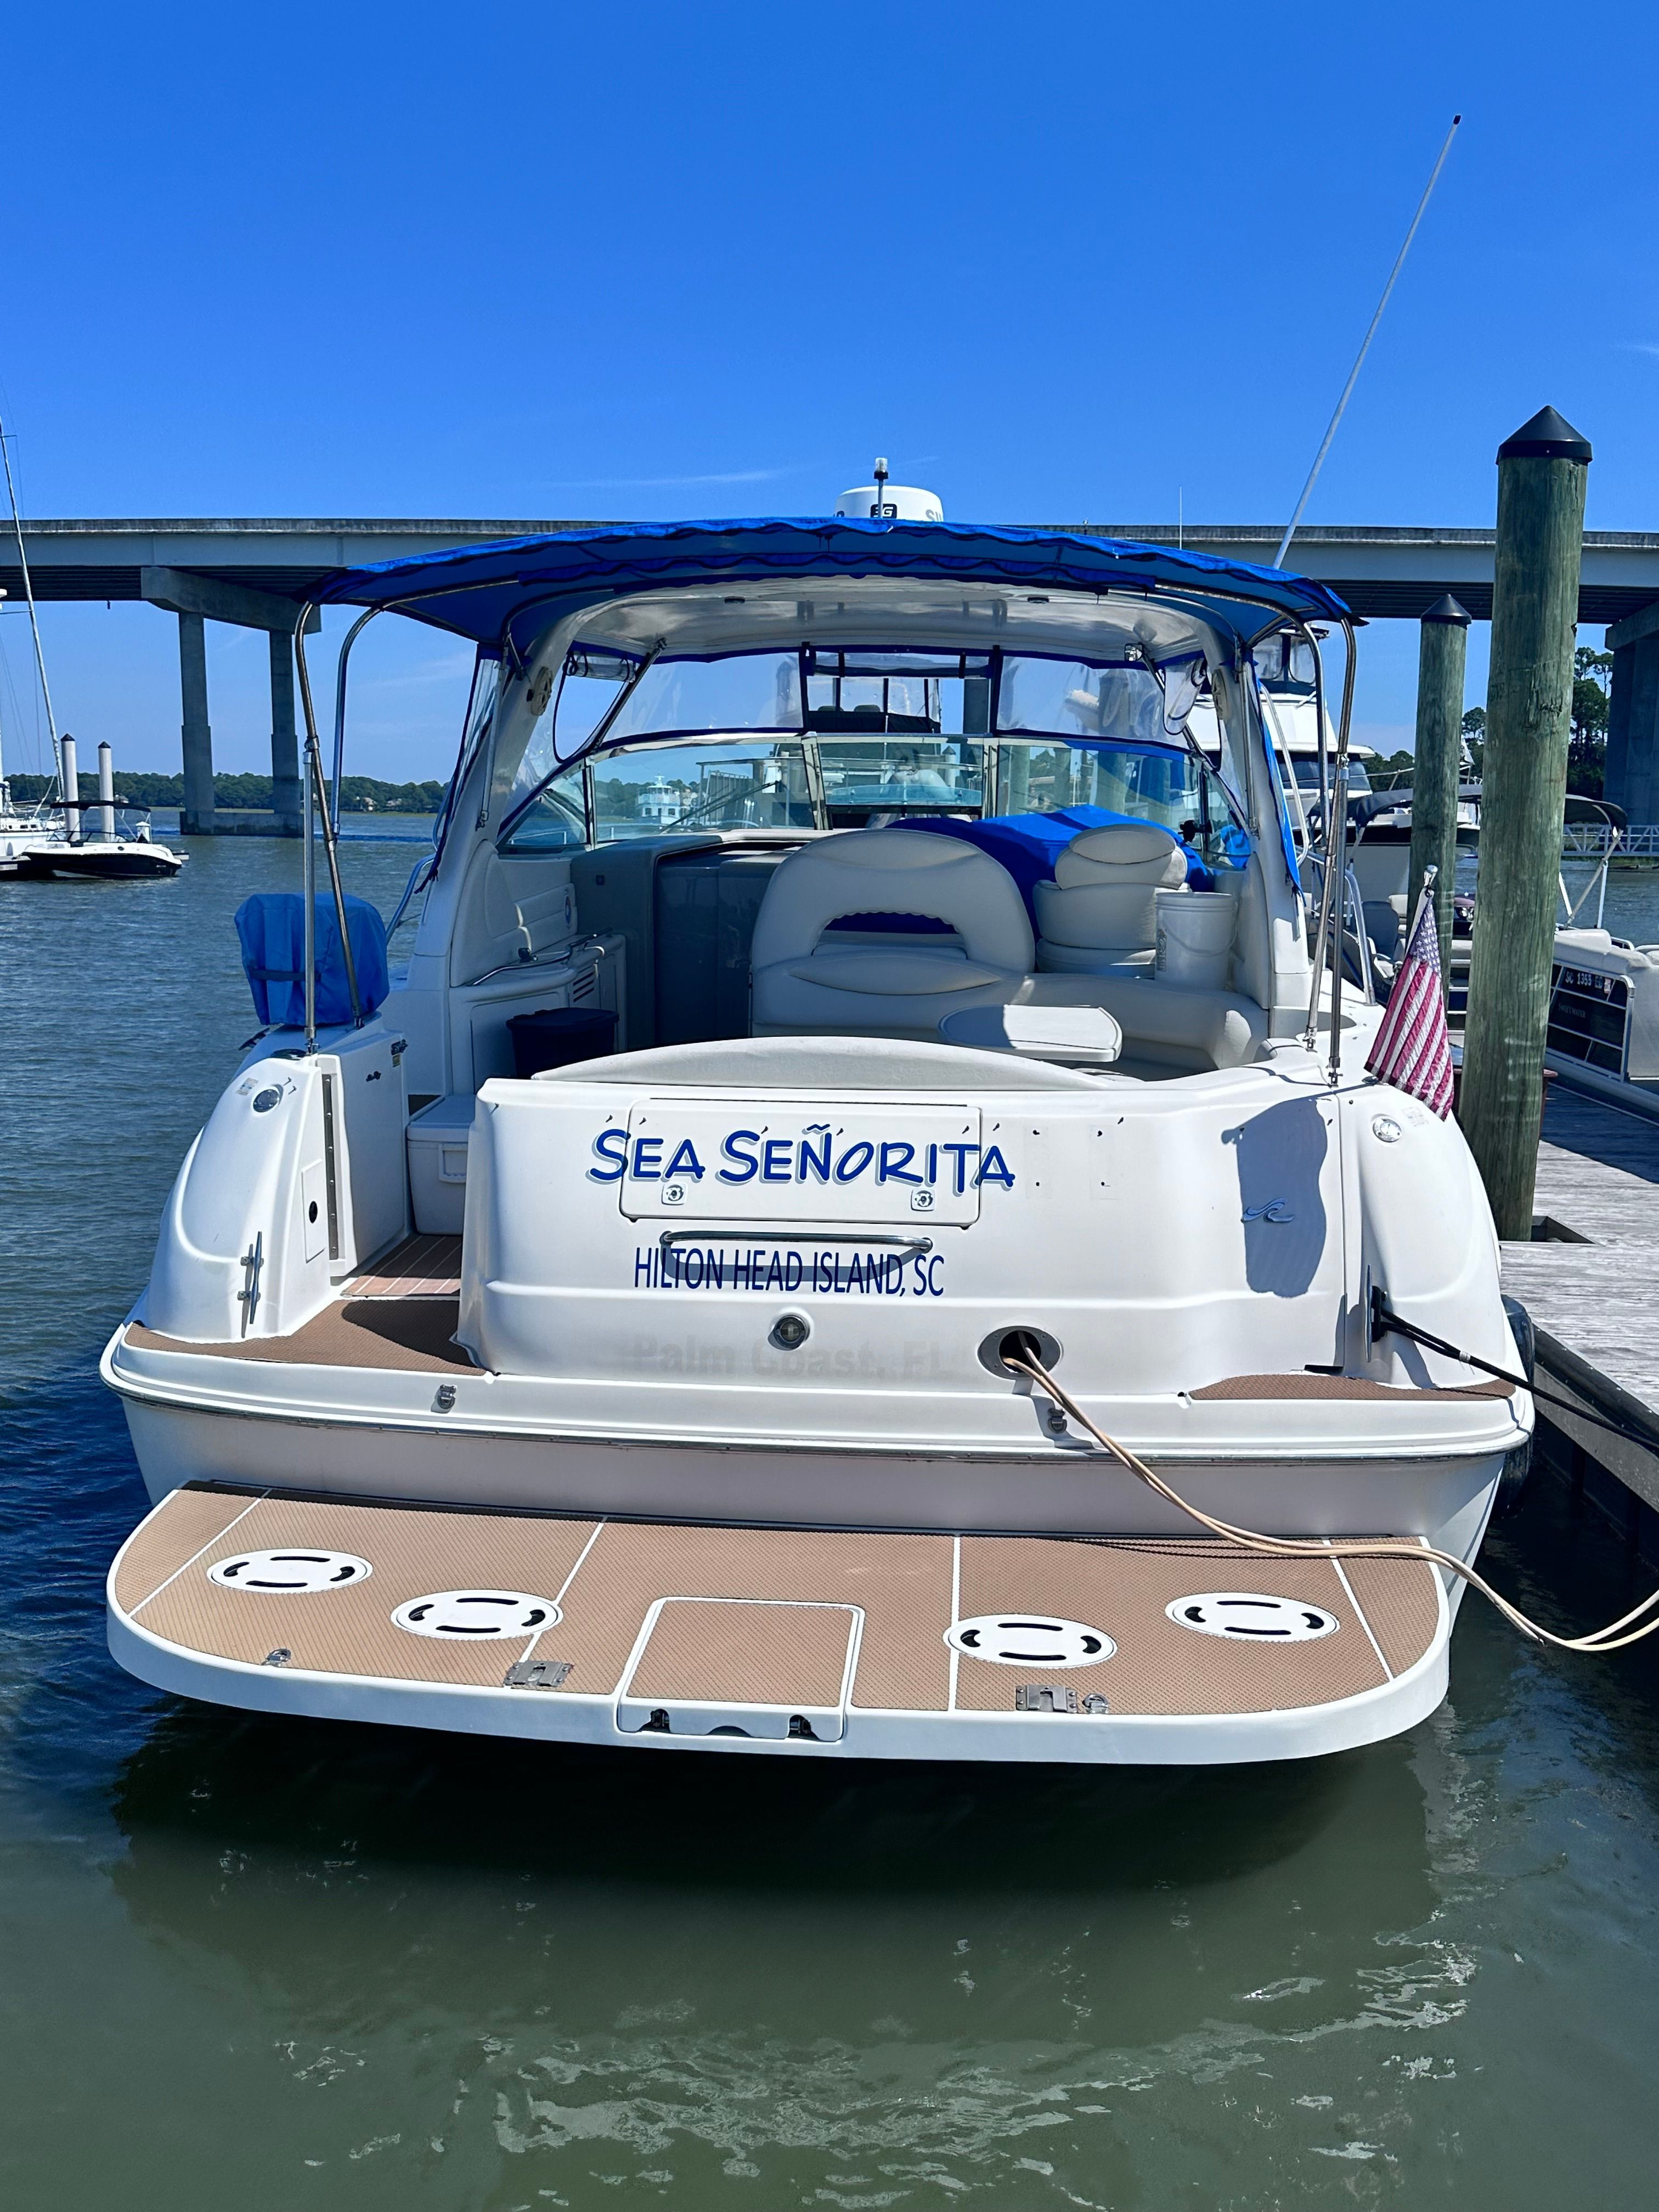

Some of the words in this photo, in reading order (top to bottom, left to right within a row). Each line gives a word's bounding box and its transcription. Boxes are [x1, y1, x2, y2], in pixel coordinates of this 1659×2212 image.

[585, 1128, 706, 1185] SEA
[715, 1123, 1016, 1198] SEÑORITA
[634, 1247, 724, 1290] HILTON
[733, 1249, 804, 1292] HEAD
[812, 1251, 906, 1297] ISLAND,
[912, 1254, 945, 1297] SC
[632, 1334, 735, 1374] Palm
[902, 1340, 952, 1380] FL
